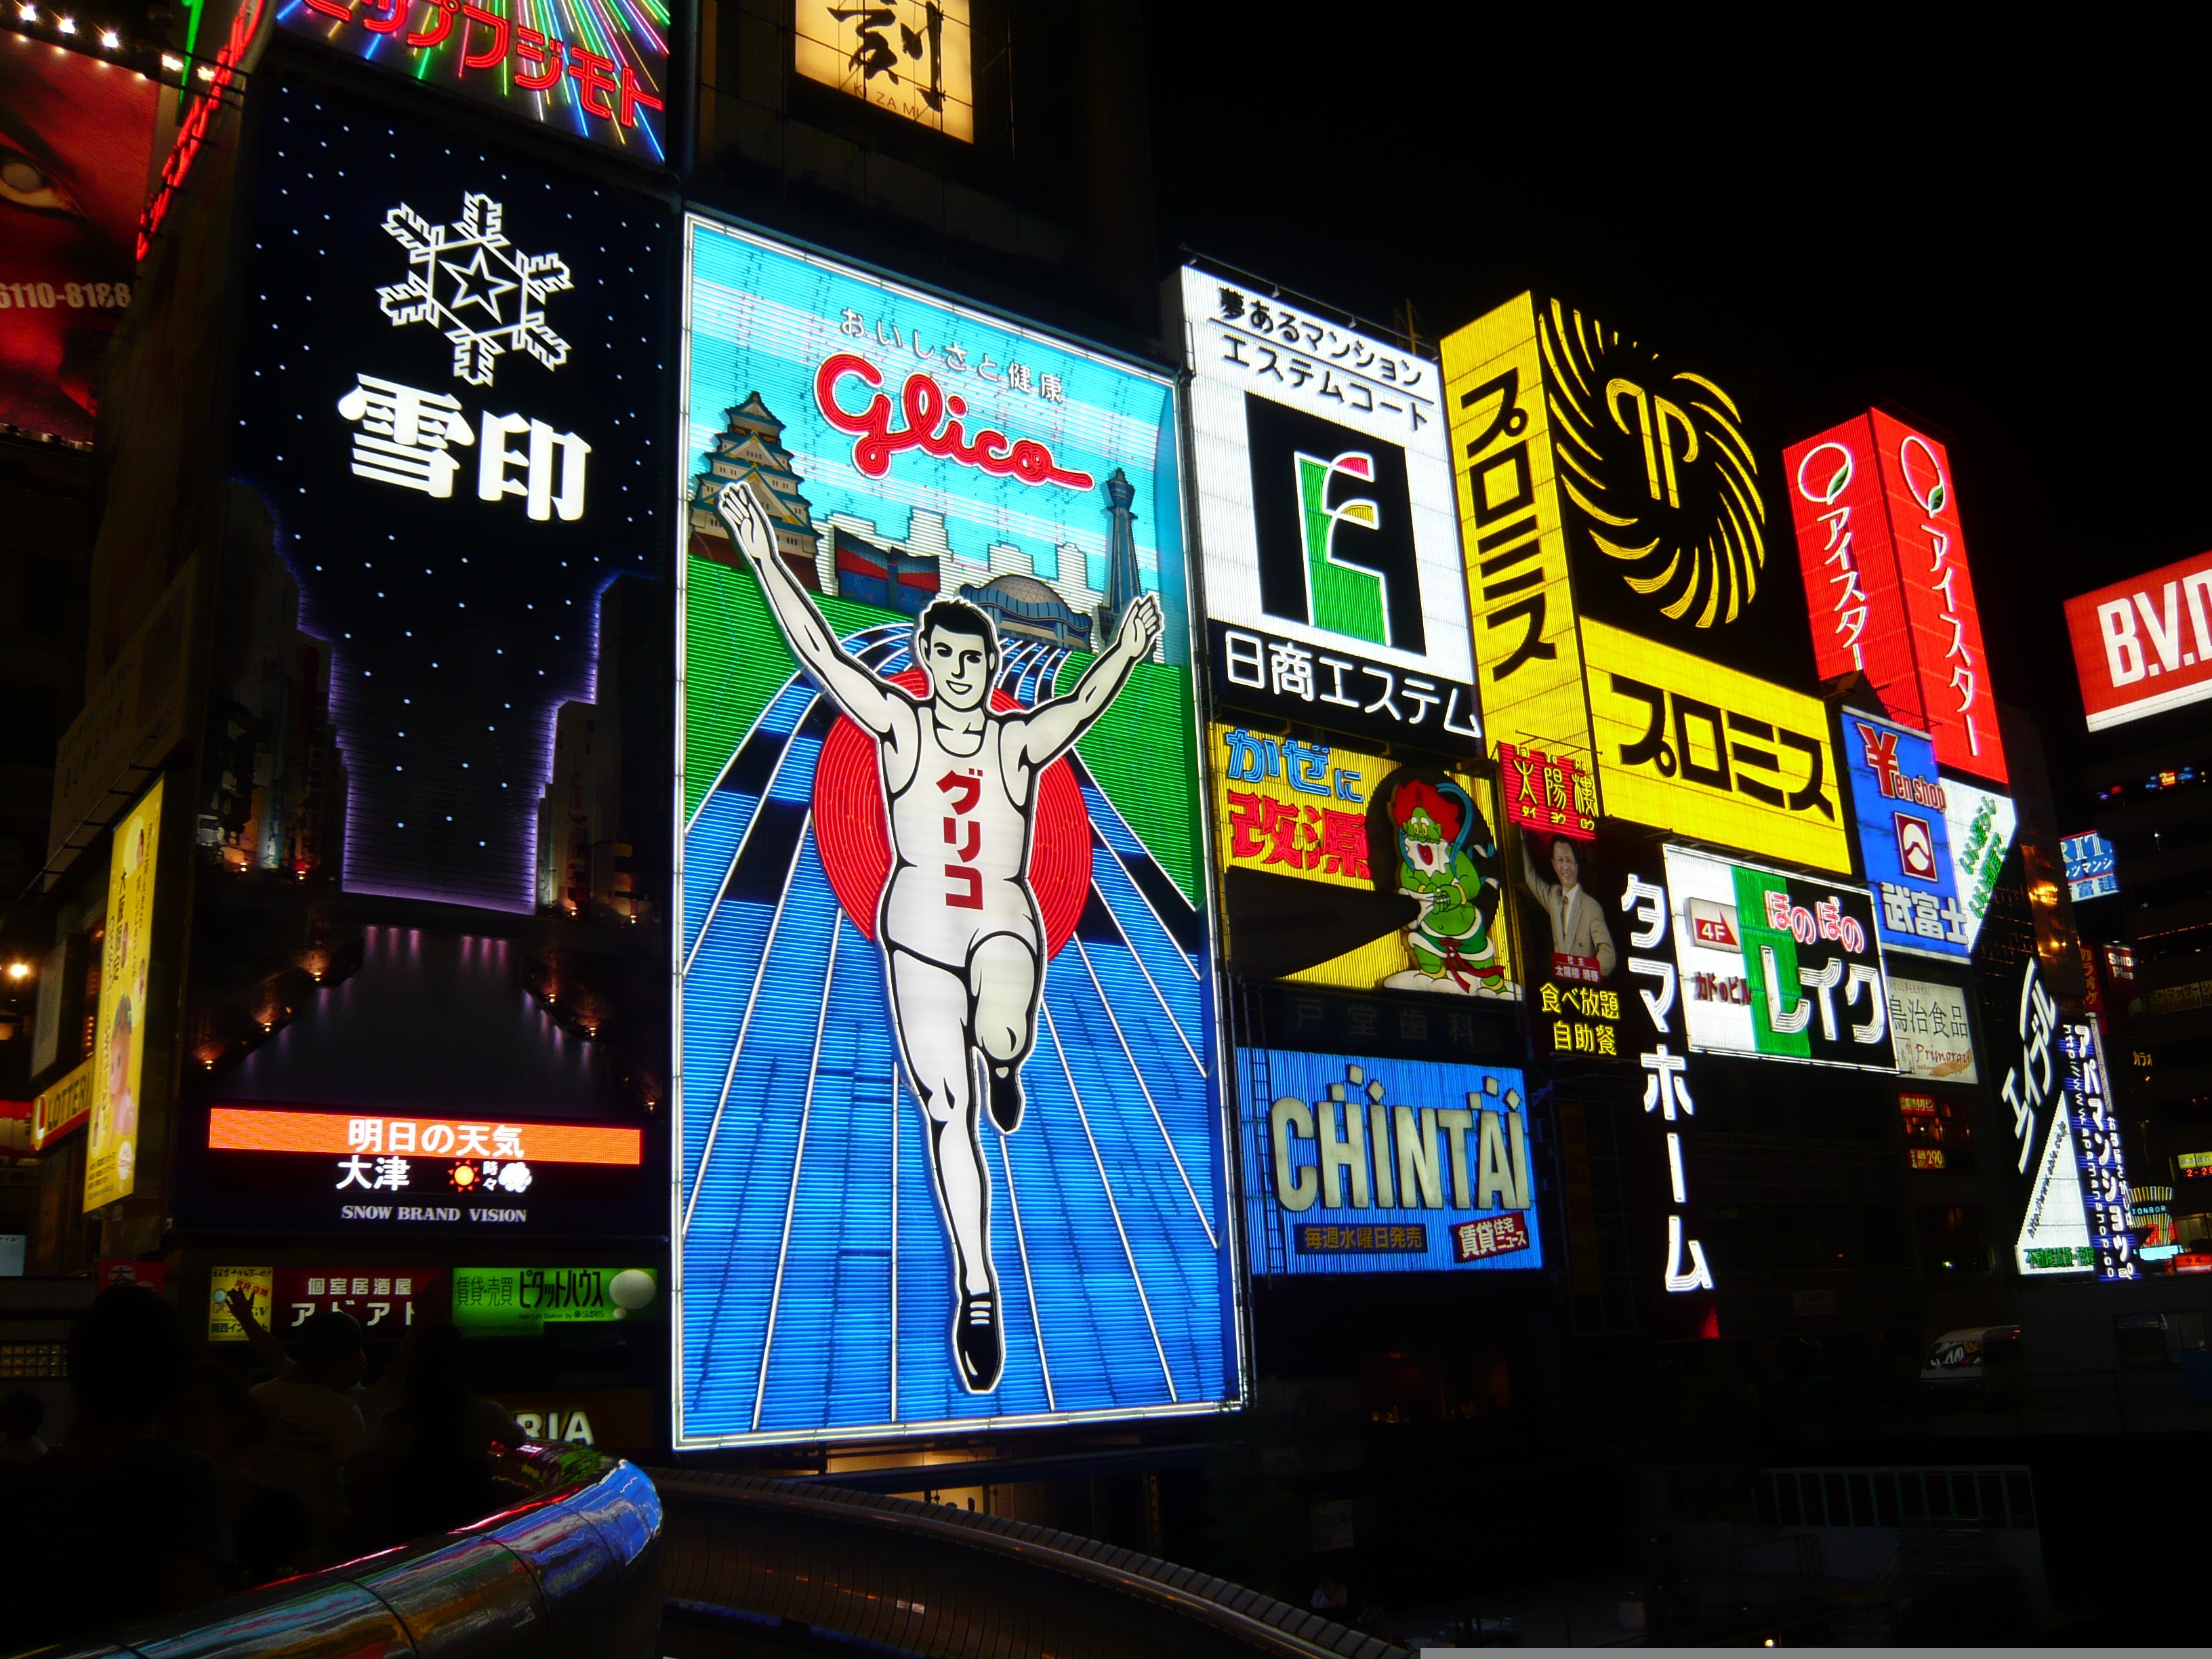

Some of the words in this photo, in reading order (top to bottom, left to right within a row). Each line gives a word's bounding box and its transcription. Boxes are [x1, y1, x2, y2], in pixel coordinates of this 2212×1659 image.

[854, 82, 920, 119] KZAMI
[840, 307, 1063, 404] おいしさと健康
[1217, 286, 1422, 387] 夢あるマンション
[1221, 334, 1427, 432] エステムコート
[337, 373, 592, 522] 雪印
[813, 351, 1096, 491] Glico
[1460, 367, 1558, 683] プロミス
[1817, 507, 1867, 672] アイスター
[1921, 524, 1978, 756] アイスター
[1225, 630, 1482, 739] 日商エステム
[1225, 728, 1365, 803] かぜに
[1609, 673, 1836, 822] プロミス
[935, 767, 984, 911] グリコ
[1227, 788, 1373, 880] 改源
[1701, 922, 1725, 941] 4F
[1763, 889, 1864, 954] ほのぼの
[1881, 881, 1969, 945] 武富士
[1539, 982, 1620, 1020] 食べ放題
[1760, 945, 1885, 1044] レイク
[2081, 949, 2099, 1004] カラオケ
[1553, 1020, 1617, 1056] 自助餐
[2001, 956, 2056, 1175] エイブル
[47, 1071, 91, 1132] LOTTERI
[1620, 874, 1713, 1292] タマホーム
[335, 1154, 411, 1191] 大津
[348, 1118, 525, 1158] 明日の天気
[1271, 1063, 1531, 1212] CHINTAI
[2074, 1024, 2133, 1280] アパマンショップ
[482, 1160, 499, 1191] 時々
[341, 1204, 394, 1220] SNOW
[397, 1206, 461, 1221] BRAND
[468, 1208, 527, 1223] VISION
[1304, 1227, 1424, 1250] 毎週水曜日発売
[1458, 1221, 1496, 1259] 賃貸
[308, 1277, 412, 1296] 個室居酒屋
[455, 1275, 514, 1307] 賃貸・売買
[519, 1269, 604, 1309] ピタットハウス
